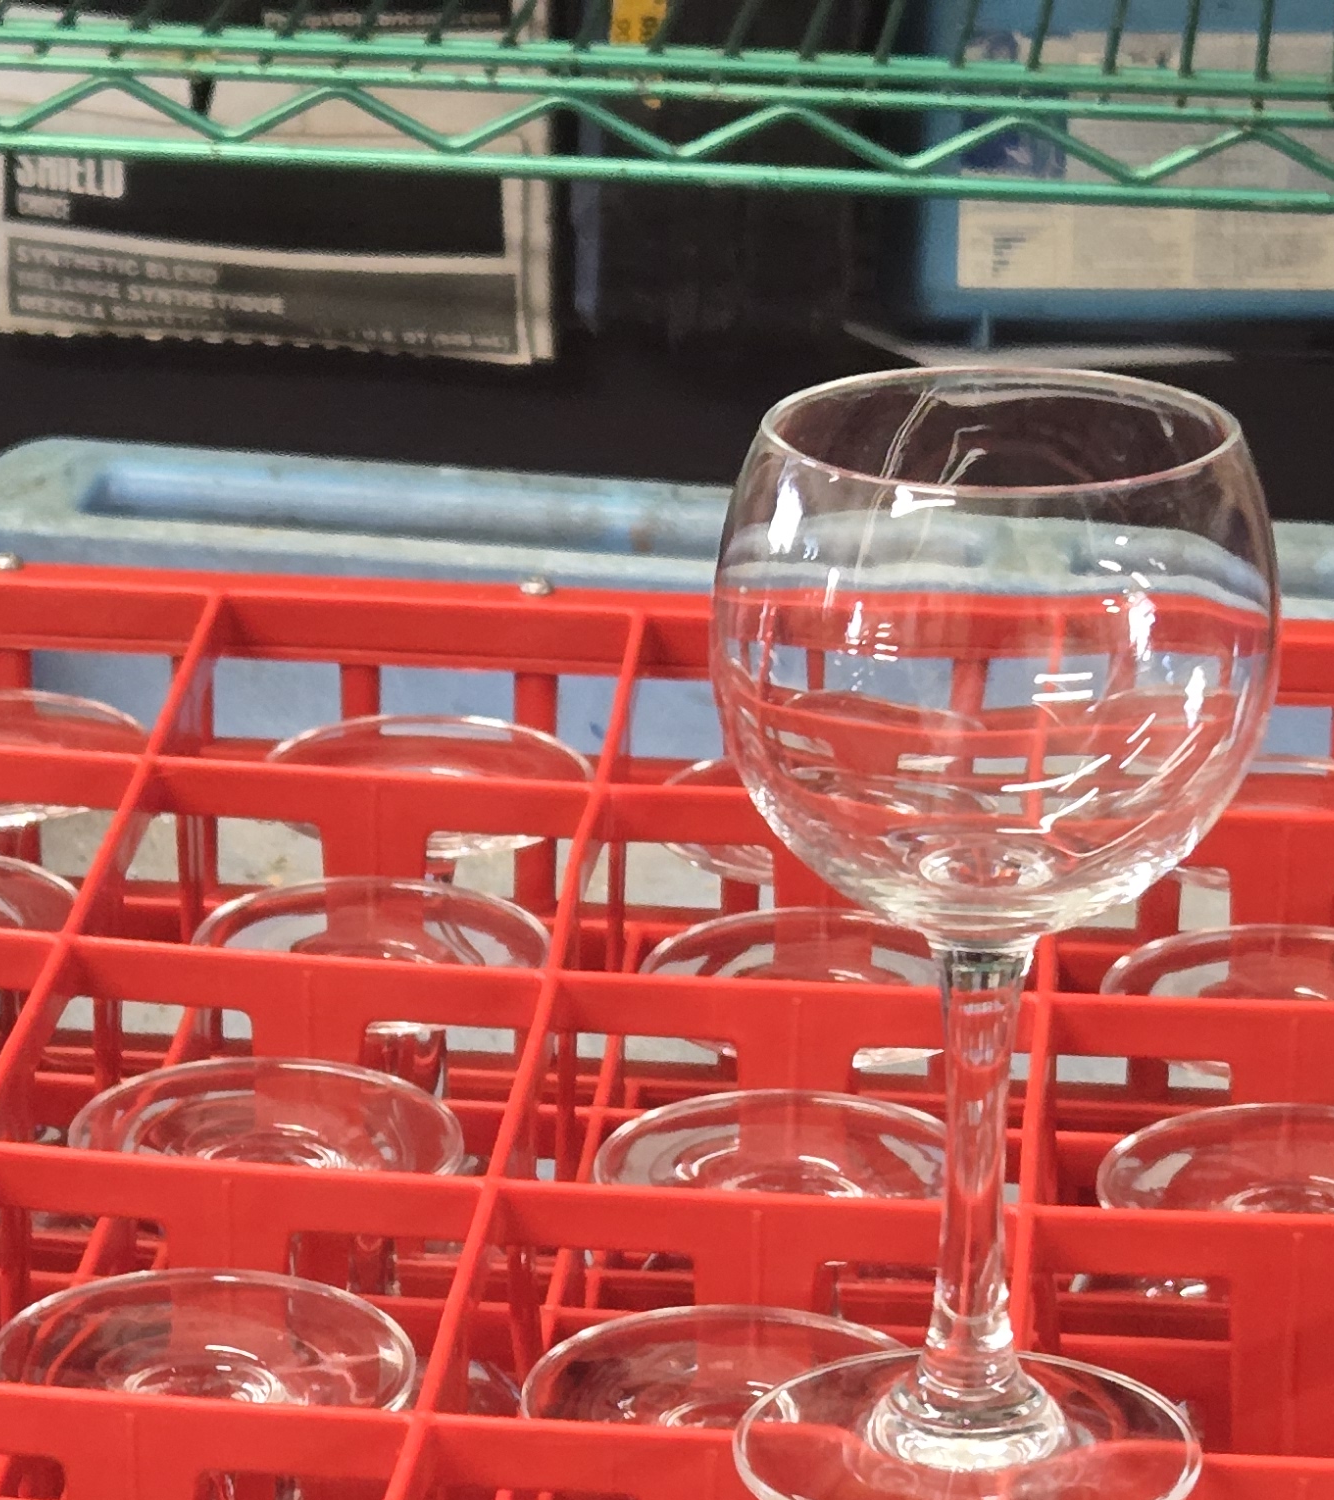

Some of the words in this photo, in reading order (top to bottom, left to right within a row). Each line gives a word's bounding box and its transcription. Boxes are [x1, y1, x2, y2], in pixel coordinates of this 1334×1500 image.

[14, 153, 125, 200] SHIELD
[16, 245, 140, 277] SYNTHETIC
[144, 259, 219, 285] BLEND
